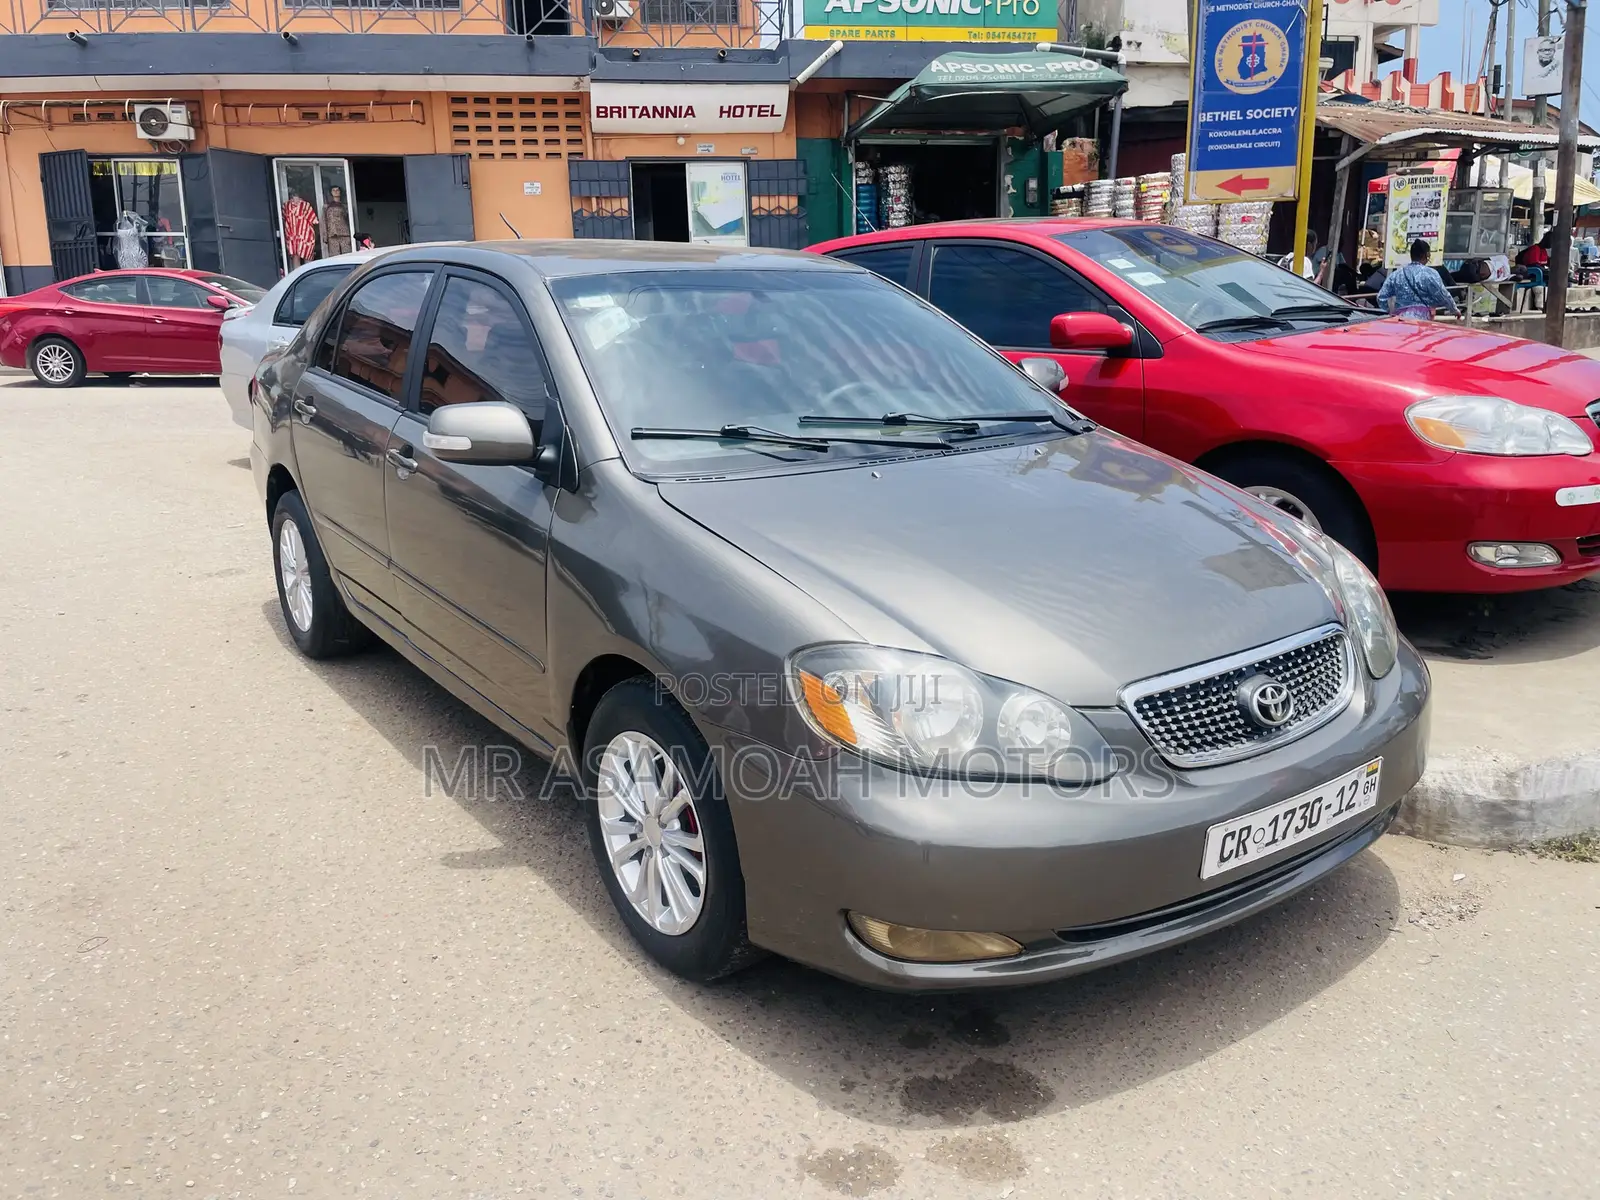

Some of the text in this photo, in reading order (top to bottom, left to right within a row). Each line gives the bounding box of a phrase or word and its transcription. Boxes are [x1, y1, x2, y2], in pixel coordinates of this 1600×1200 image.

[1216, 2, 1252, 12] METHODIST
[1253, 0, 1303, 9] CHURCH-GHAN
[829, 29, 896, 38] SPARE PARTS
[968, 31, 984, 40] Tel:
[1219, 22, 1253, 55] METHODIST
[1255, 21, 1282, 40] CHURCH
[1279, 41, 1287, 68] GHANA
[931, 60, 1100, 73] APSONIC-PRO
[595, 104, 782, 119] BRITANNIA HOTEL
[1199, 106, 1297, 122] BETHEL SOCIETY
[1253, 141, 1281, 149] CIRCUIT)
[1419, 175, 1439, 184] LUNCH
[1363, 777, 1377, 796] GH
[1219, 779, 1359, 863] CR 1730-12
